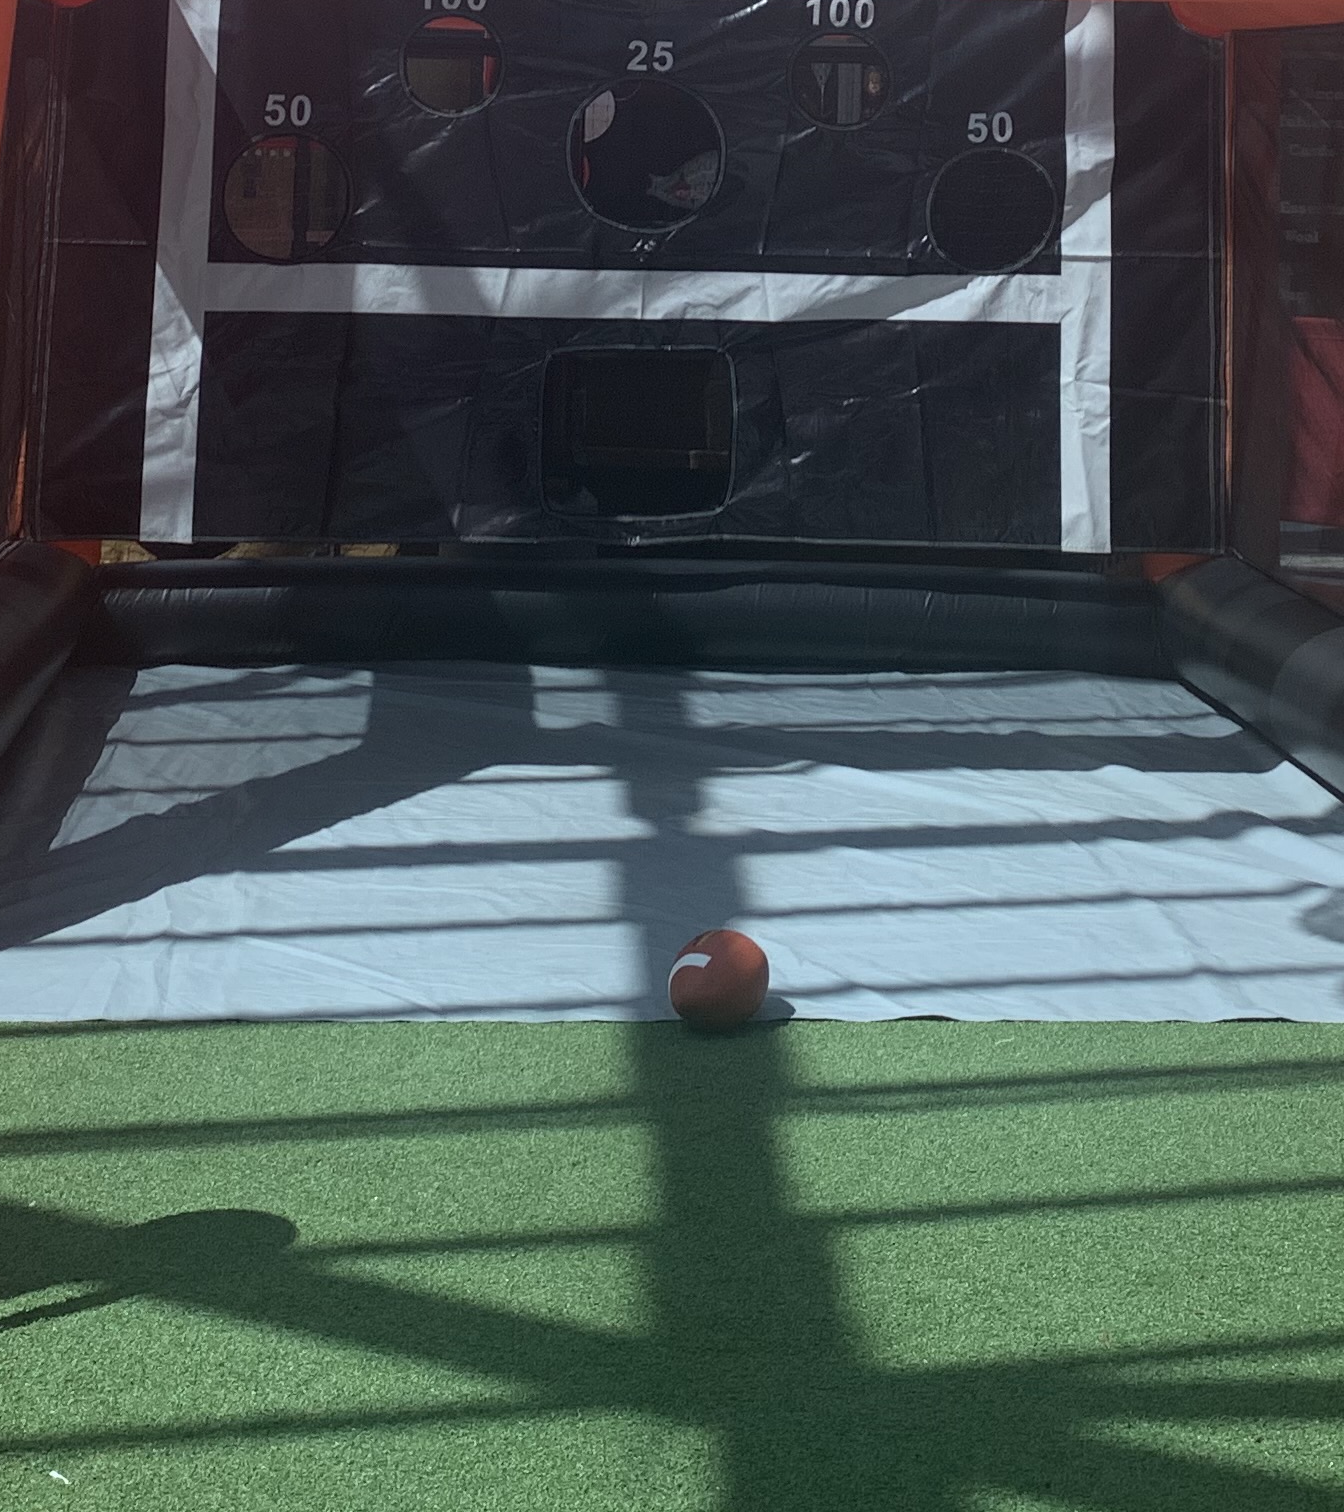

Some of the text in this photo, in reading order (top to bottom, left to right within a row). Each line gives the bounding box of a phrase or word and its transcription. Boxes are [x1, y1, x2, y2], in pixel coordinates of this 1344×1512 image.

[627, 40, 674, 73] 25
[263, 94, 312, 127] 50
[967, 111, 1013, 144] 50
